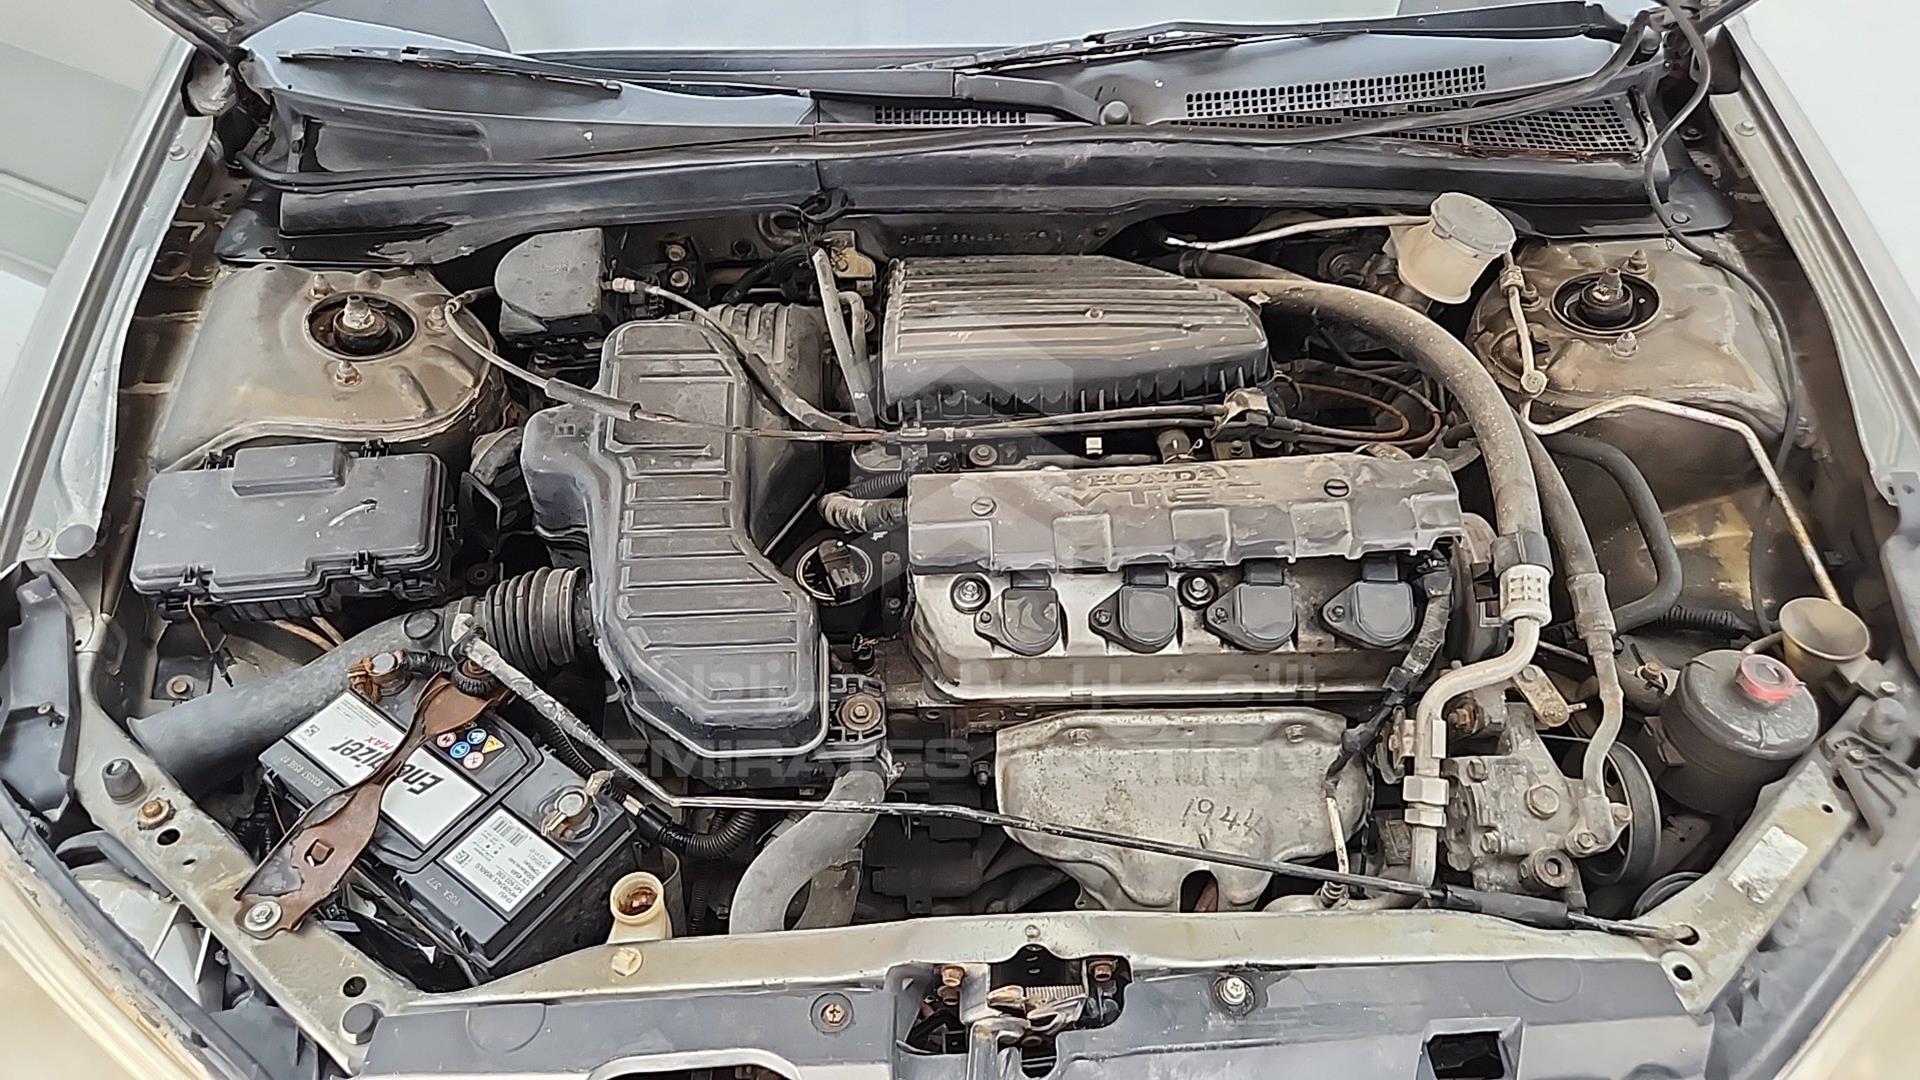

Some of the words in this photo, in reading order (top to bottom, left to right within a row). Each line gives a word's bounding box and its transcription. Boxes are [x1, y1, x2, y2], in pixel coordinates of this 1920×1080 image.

[1087, 467, 1227, 488] HONDA
[1069, 480, 1265, 508] VTEC
[364, 734, 395, 751] MAX
